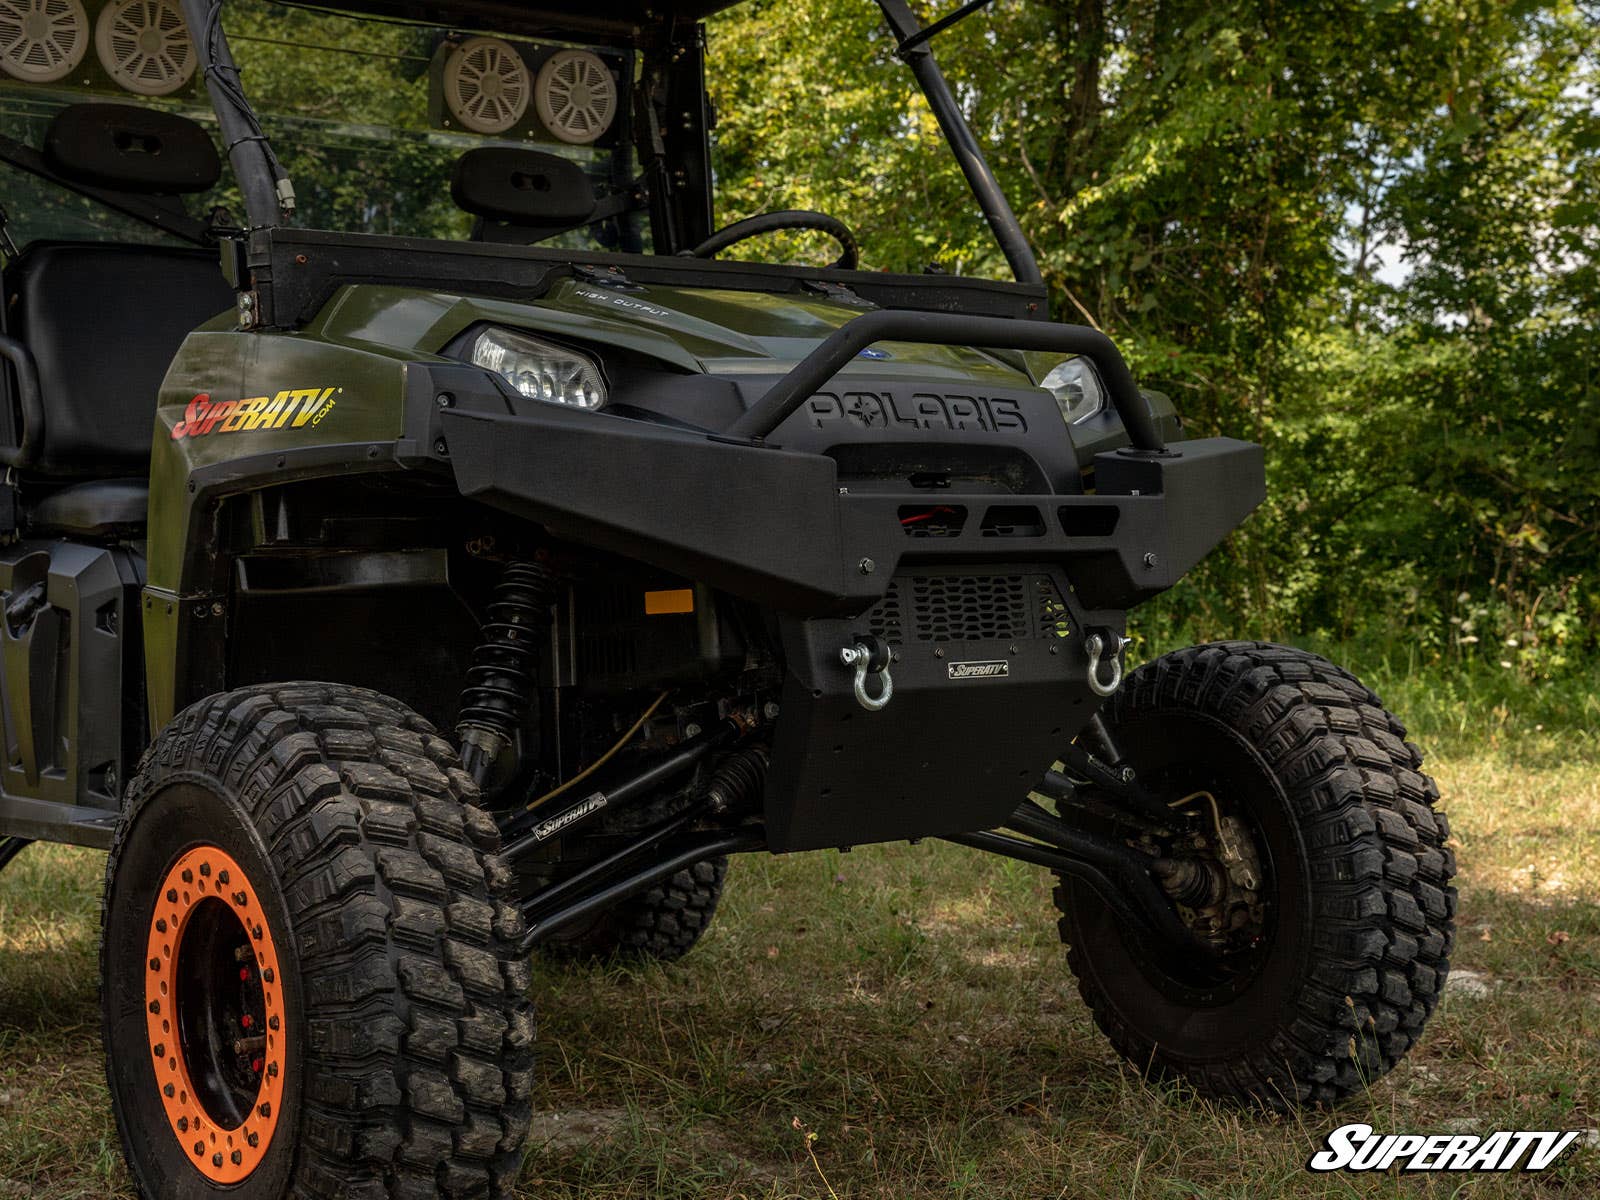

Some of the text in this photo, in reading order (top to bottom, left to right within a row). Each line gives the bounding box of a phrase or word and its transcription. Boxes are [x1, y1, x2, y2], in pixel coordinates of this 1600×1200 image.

[576, 290, 669, 316] HIGH OUTPUT
[170, 386, 336, 440] SUPERATV
[804, 391, 1028, 434] POLARIS
[954, 664, 1003, 676] SUPERATV
[542, 801, 597, 836] SUPERATV
